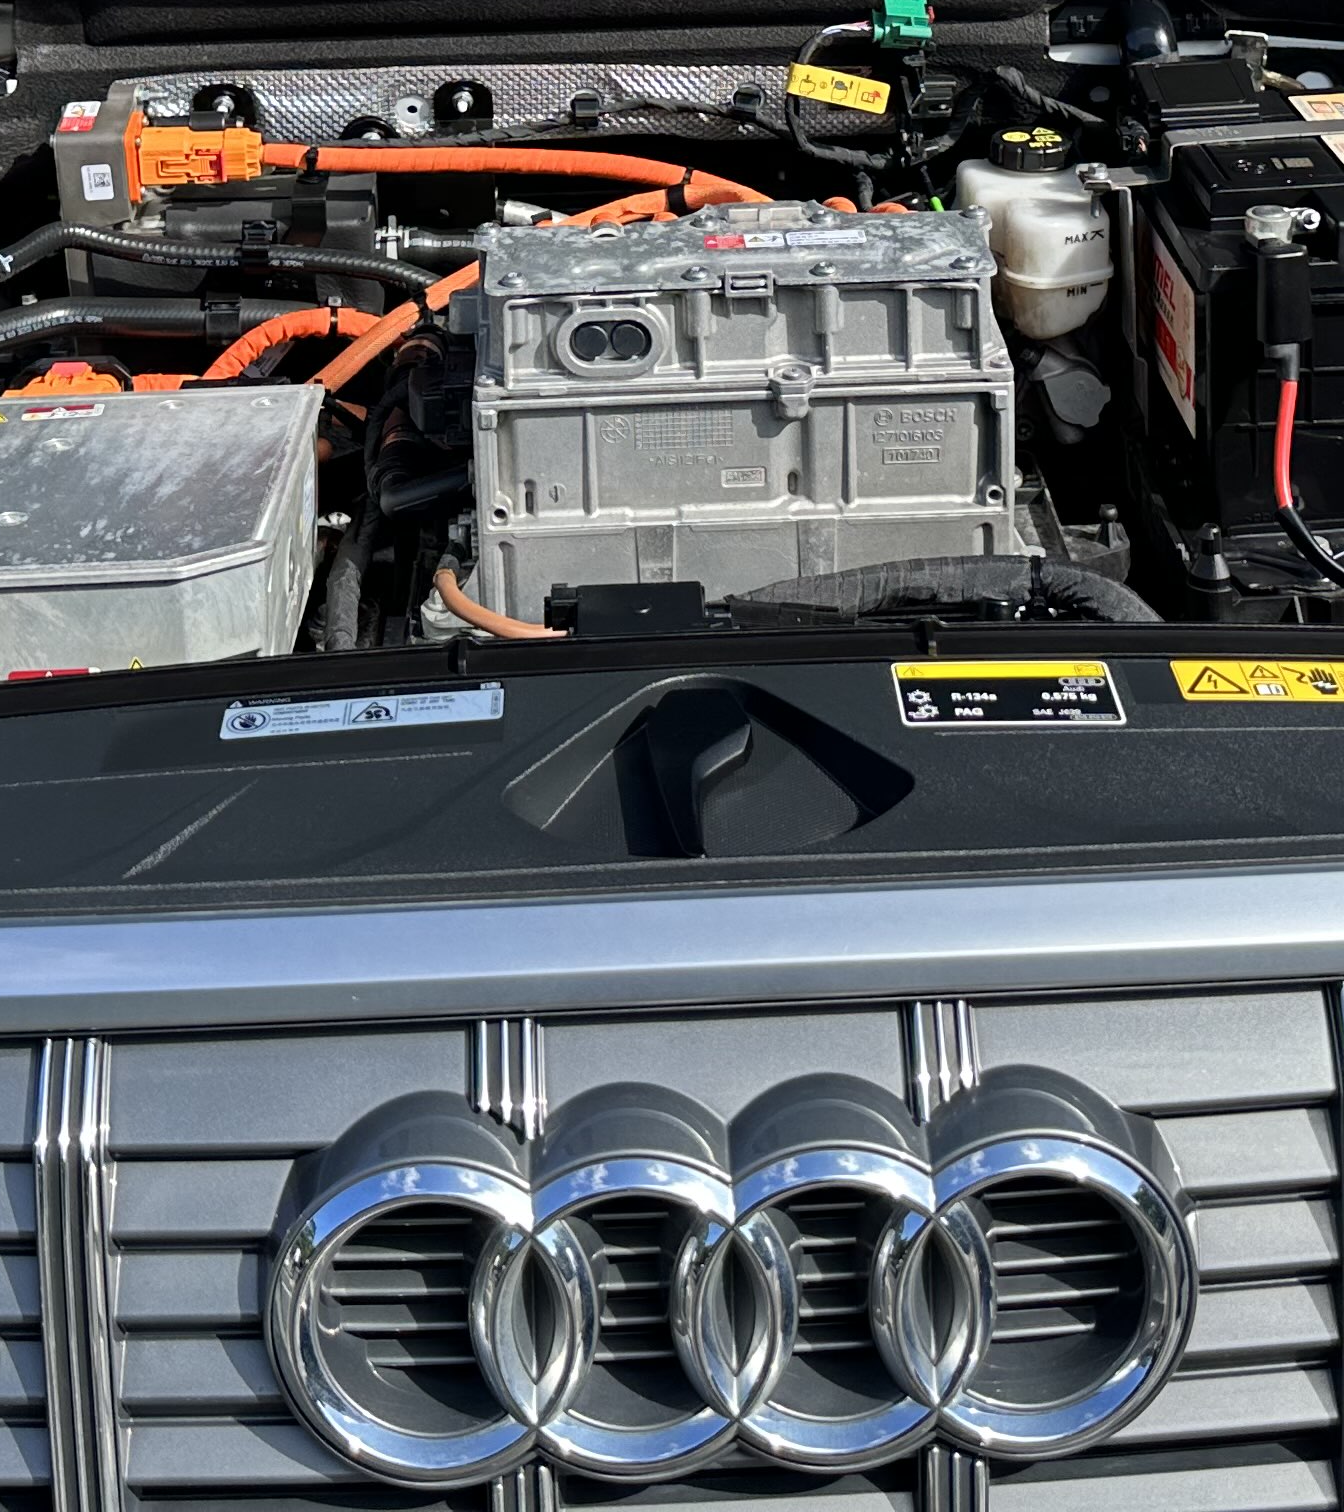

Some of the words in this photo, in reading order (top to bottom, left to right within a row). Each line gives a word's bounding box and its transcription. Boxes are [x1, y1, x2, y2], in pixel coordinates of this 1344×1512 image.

[1064, 231, 1088, 245] MAX
[1066, 285, 1088, 297] MIN
[900, 407, 956, 424] BOSCH
[951, 691, 998, 701] R-134a
[1080, 691, 1098, 703] kg
[954, 707, 984, 717] PAG
